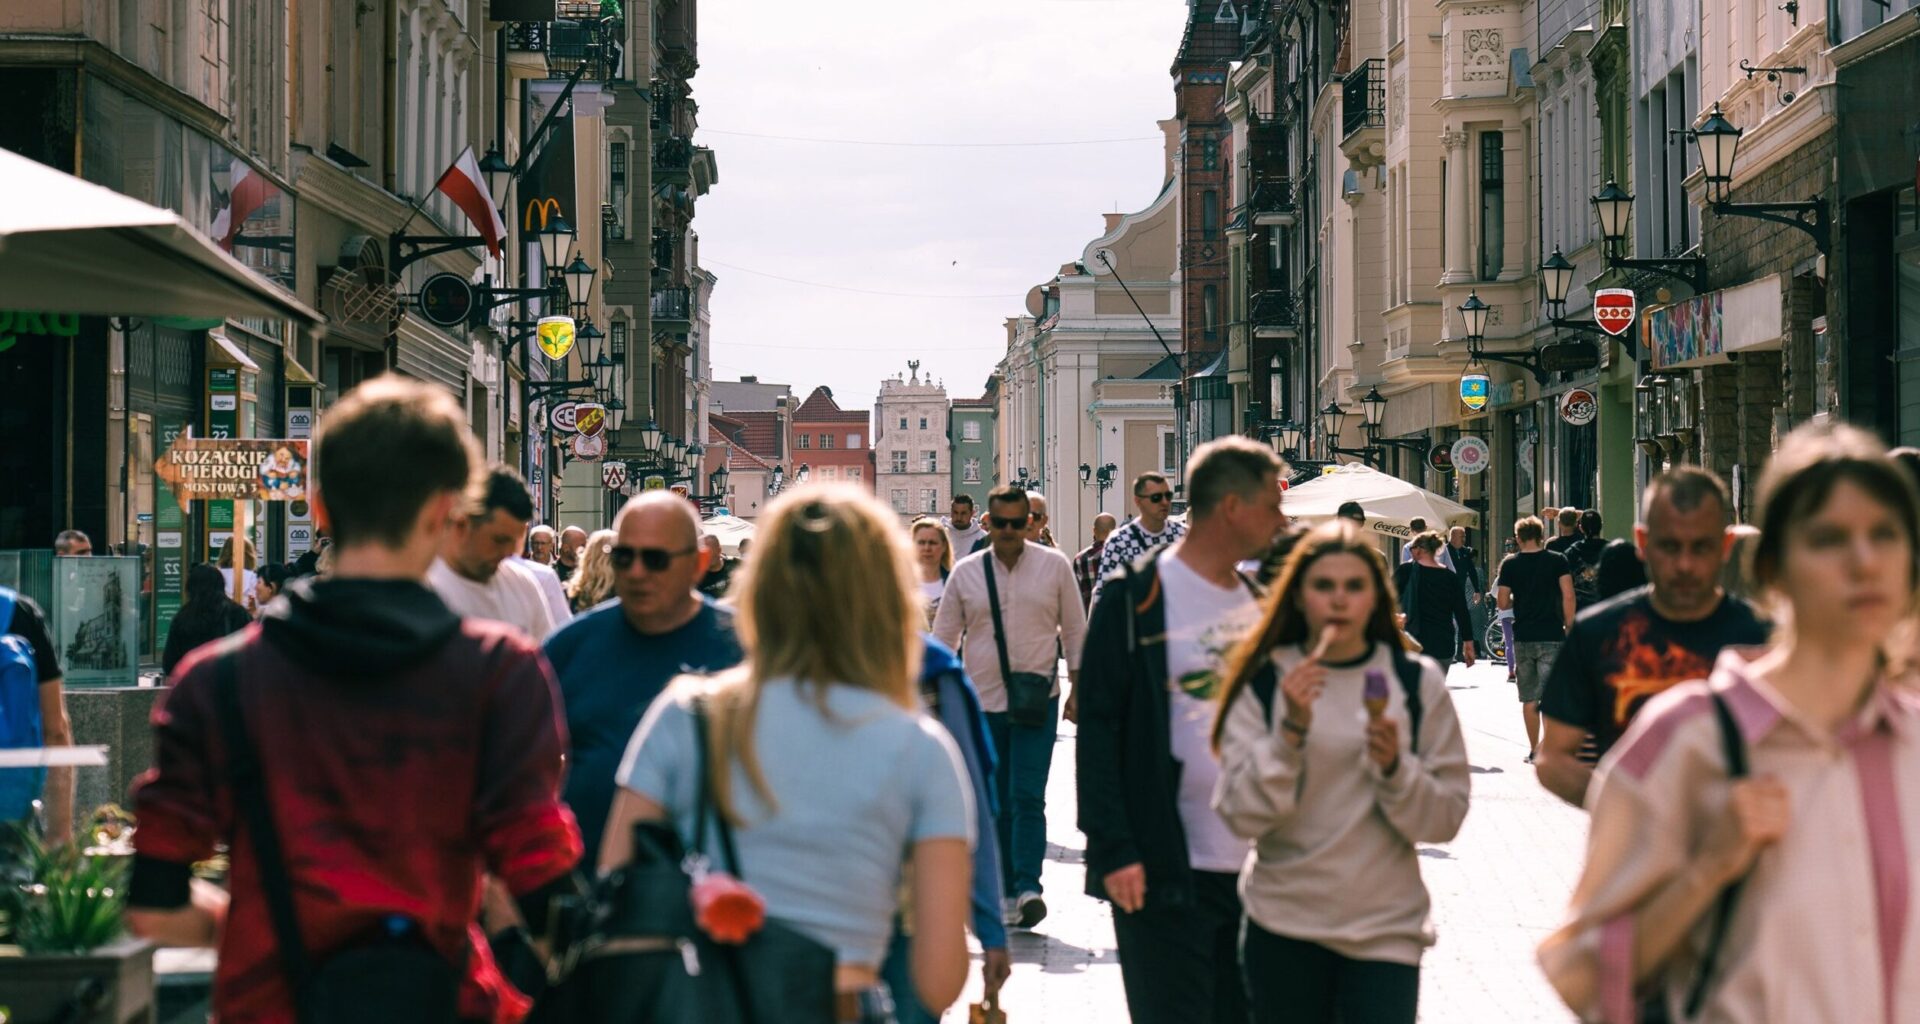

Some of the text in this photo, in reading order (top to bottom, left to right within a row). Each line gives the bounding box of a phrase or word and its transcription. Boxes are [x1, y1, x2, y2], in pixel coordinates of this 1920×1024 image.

[172, 450, 267, 465] KOZACKIE
[181, 464, 258, 479] PIEROGI
[184, 483, 258, 493] MOSTOWA 3
